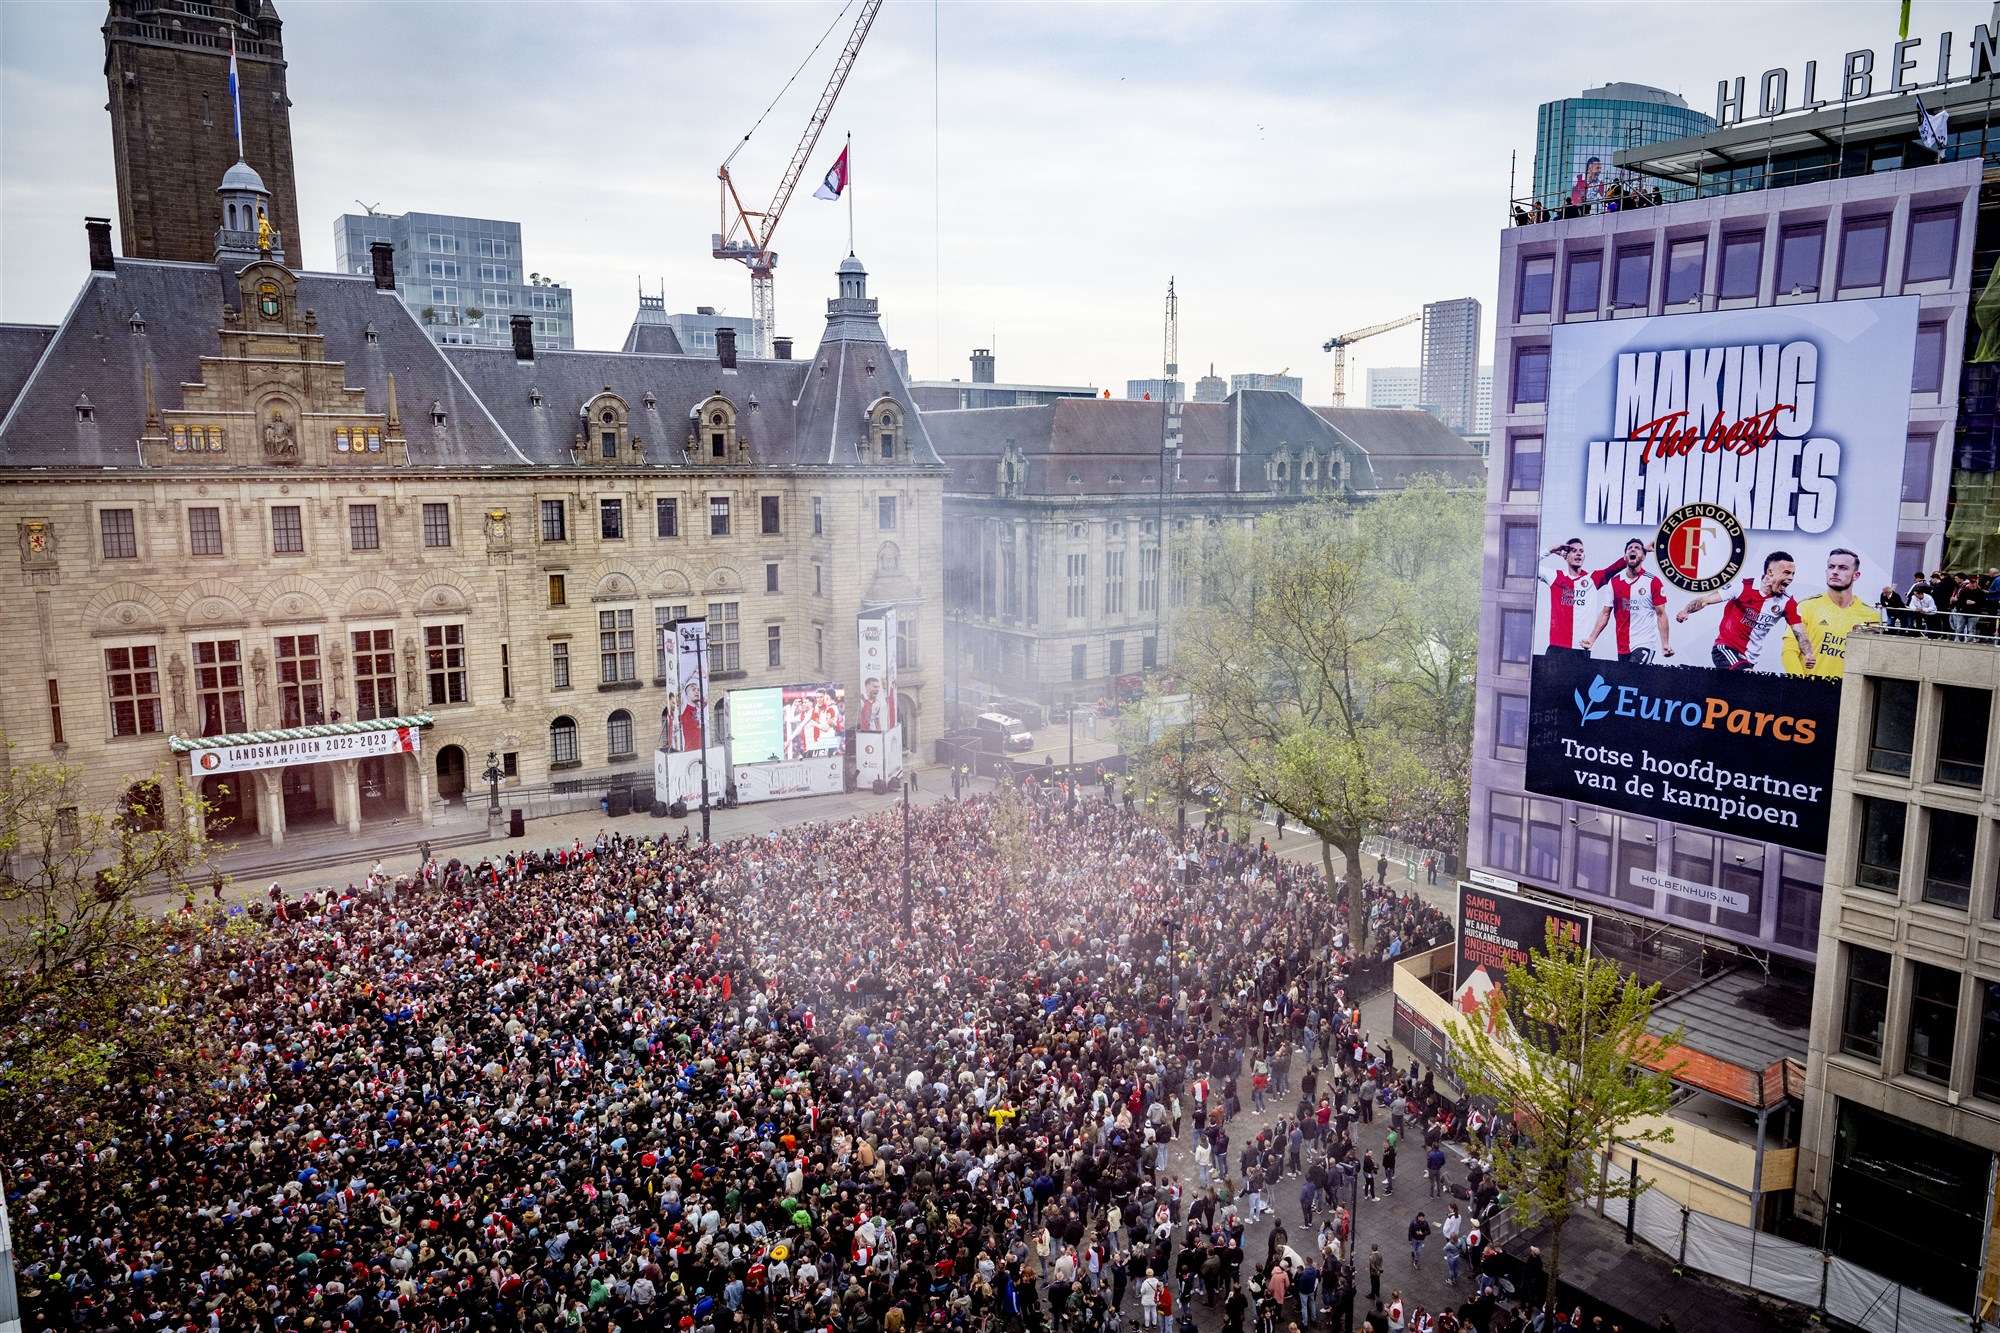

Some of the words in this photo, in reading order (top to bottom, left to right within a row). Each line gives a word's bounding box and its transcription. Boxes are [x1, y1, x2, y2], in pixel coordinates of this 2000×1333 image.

[1716, 20, 2000, 127] HOLBEIN
[1614, 341, 1818, 440] MAKING
[1630, 410, 1699, 464] The
[1703, 403, 1796, 456] best
[1585, 438, 1841, 533] MEMORIES
[1662, 505, 1740, 537] FEYENOORD
[1679, 526, 1716, 569] F
[1659, 558, 1739, 590] ROTTERDAM
[1823, 632, 1846, 646] Eur
[1615, 685, 1817, 744] EuroParcs
[229, 741, 320, 761] LANDSKAMPIOEN
[326, 734, 387, 751] 2022-2023
[1561, 738, 1634, 768] Trotse
[1641, 750, 1822, 803] hoofdpartner
[1574, 769, 1617, 791] van
[1624, 775, 1654, 798] de
[1662, 780, 1799, 828] kampioen
[1465, 894, 1496, 912] SAMEN
[1641, 875, 1738, 906] HOLBEINHUIS.NL
[1465, 906, 1501, 927] WERKEN
[1465, 918, 1475, 929] WE
[1476, 922, 1489, 932] AAN
[1490, 925, 1498, 935] DE
[1464, 927, 1500, 945] HUISKAMER
[1501, 937, 1519, 950] VOOR
[1464, 937, 1528, 964] ONDERNEMEND
[1464, 948, 1512, 974] ROTTERDA
